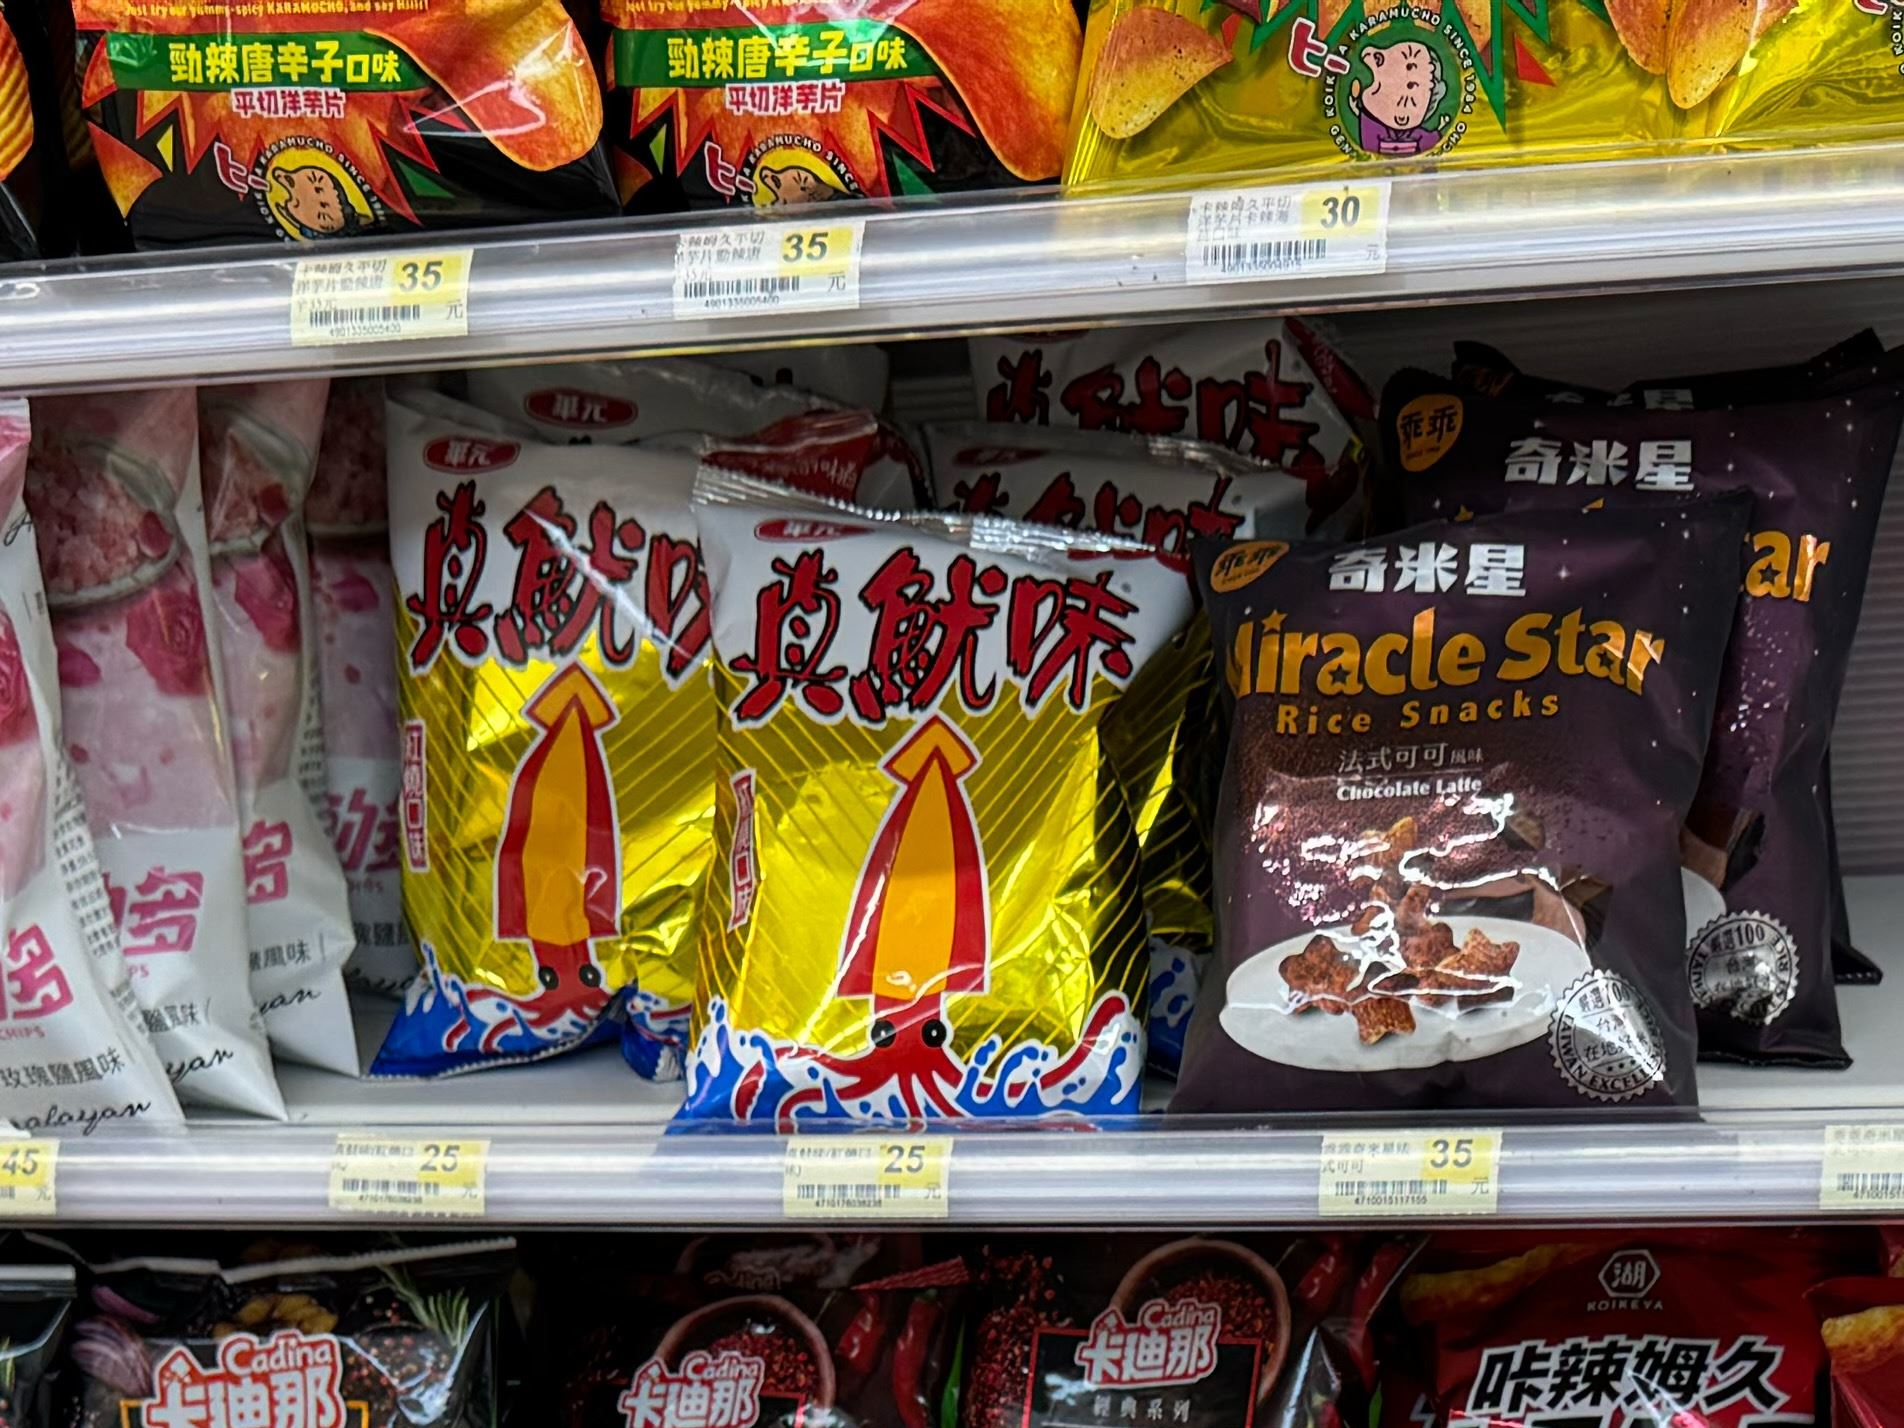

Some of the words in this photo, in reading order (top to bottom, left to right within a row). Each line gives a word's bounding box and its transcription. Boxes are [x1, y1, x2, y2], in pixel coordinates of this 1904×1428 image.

[168, 40, 402, 86] 勁辣唐辛子口味
[667, 31, 908, 80] 勁辣唐辛子口味
[1347, 5, 1442, 43] KARAMUCHO
[1442, 24, 1473, 69] SINCE
[1460, 72, 1477, 114] 1984
[232, 87, 346, 119] 平切洋芋片
[725, 79, 846, 116] 平切洋芋片
[1320, 194, 1362, 230] 30
[782, 231, 829, 264] 35
[1364, 243, 1381, 261] 元
[398, 261, 444, 293] 35
[827, 273, 848, 293] 元
[445, 300, 465, 320] 元
[1399, 403, 1459, 451] 乖乖
[443, 440, 491, 467] 華元
[1505, 436, 1695, 492] 奇米星
[1329, 542, 1526, 597] 奇米星
[732, 547, 1140, 724] 真魷味
[1496, 607, 1666, 696] Star
[1276, 704, 1372, 736] Rice
[1401, 690, 1560, 730] Snacks
[1338, 742, 1484, 774] 法式可可風味
[1336, 778, 1431, 802] Chocolate
[1436, 775, 1483, 797] Latte
[1, 1149, 40, 1177] 45
[420, 1144, 461, 1173] 25
[882, 1143, 925, 1173] 25
[1429, 1139, 1474, 1168] 35
[1471, 1176, 1489, 1195] 元
[1143, 1304, 1215, 1331] Cadina
[1586, 1298, 1664, 1313] KOIKEYA
[224, 1338, 333, 1376] Cadina
[685, 1357, 760, 1382] Cadina
[1082, 1327, 1214, 1384] 卡迪那
[1467, 1334, 1791, 1416] 咔辣姆久
